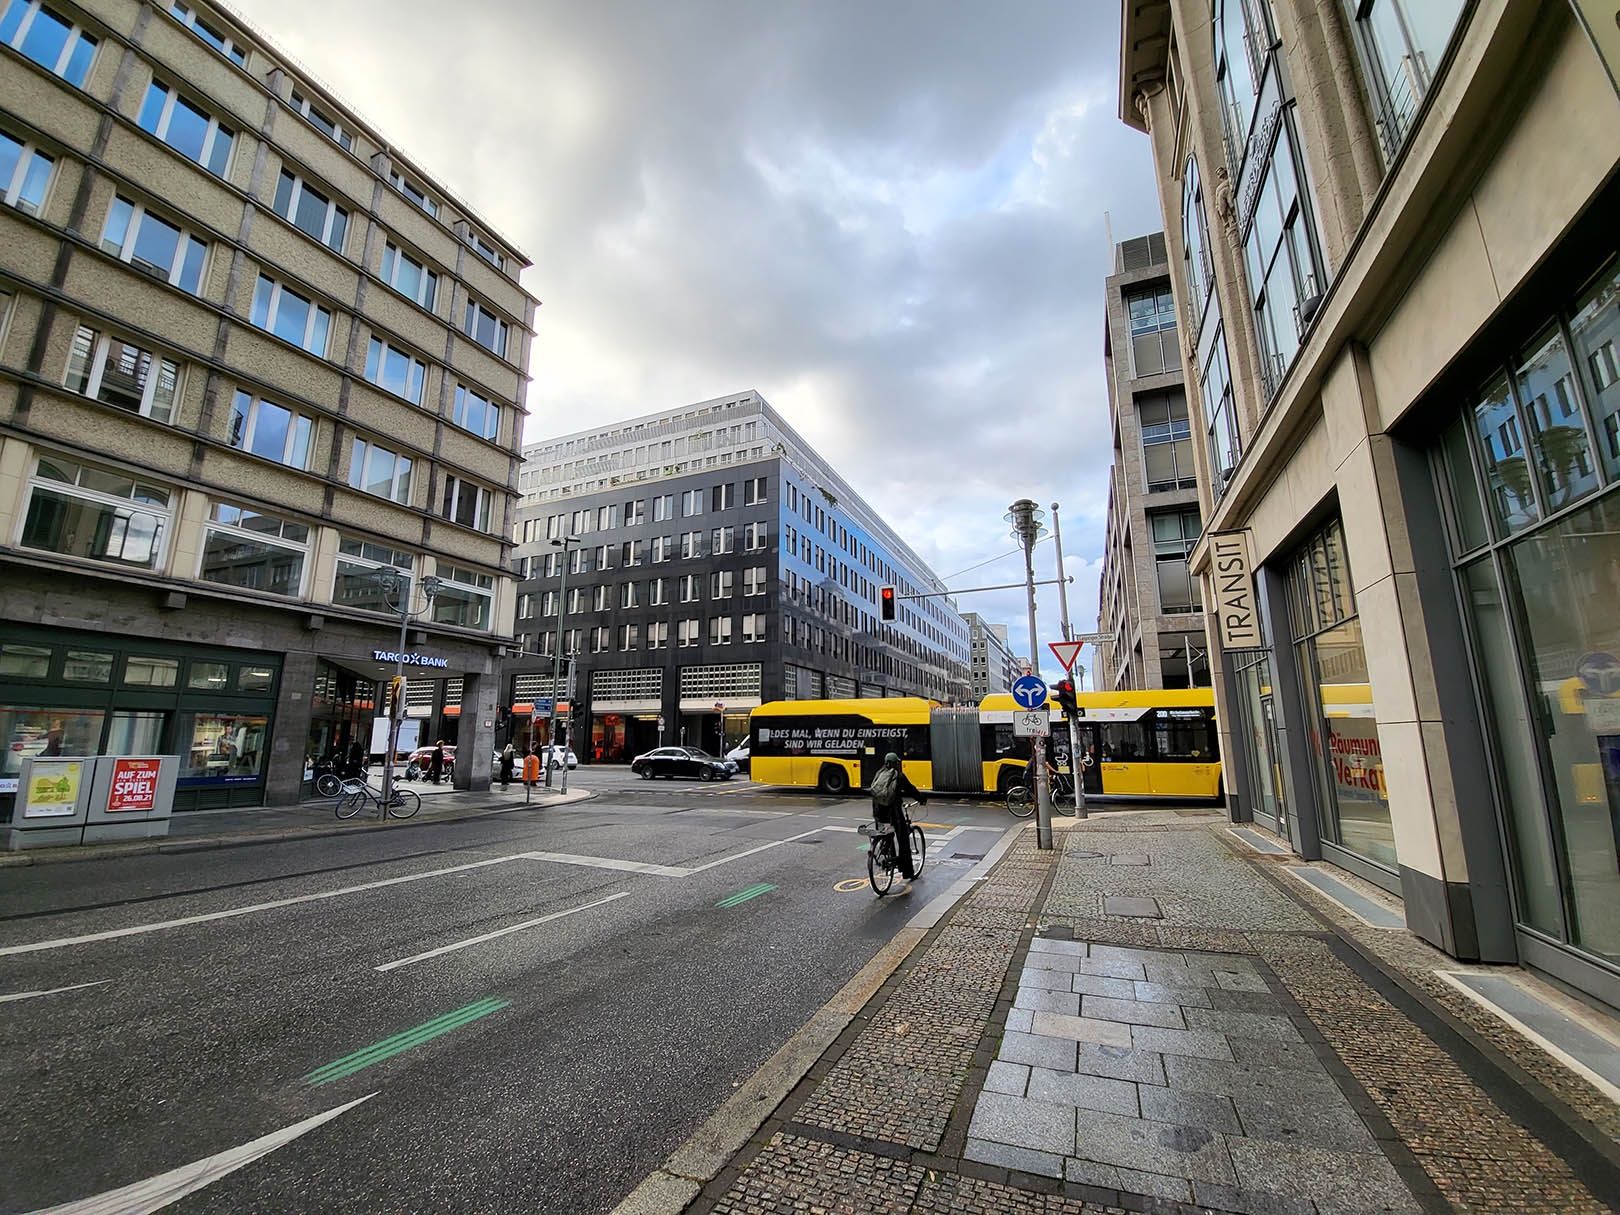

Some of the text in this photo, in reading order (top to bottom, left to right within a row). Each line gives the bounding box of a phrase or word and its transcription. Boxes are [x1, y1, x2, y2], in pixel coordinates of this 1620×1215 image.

[1215, 542, 1254, 642] TRANSIT
[420, 656, 448, 668] BANK
[791, 729, 812, 739] MAL,
[814, 728, 841, 738] WENN
[842, 728, 856, 738] DU
[857, 728, 909, 739] EINSTEIGST,
[784, 739, 867, 749] SIND WIR GELADEN.
[1329, 731, 1381, 758] Räumun
[117, 770, 156, 779] AUF ZUM
[114, 782, 152, 794] SPIEL
